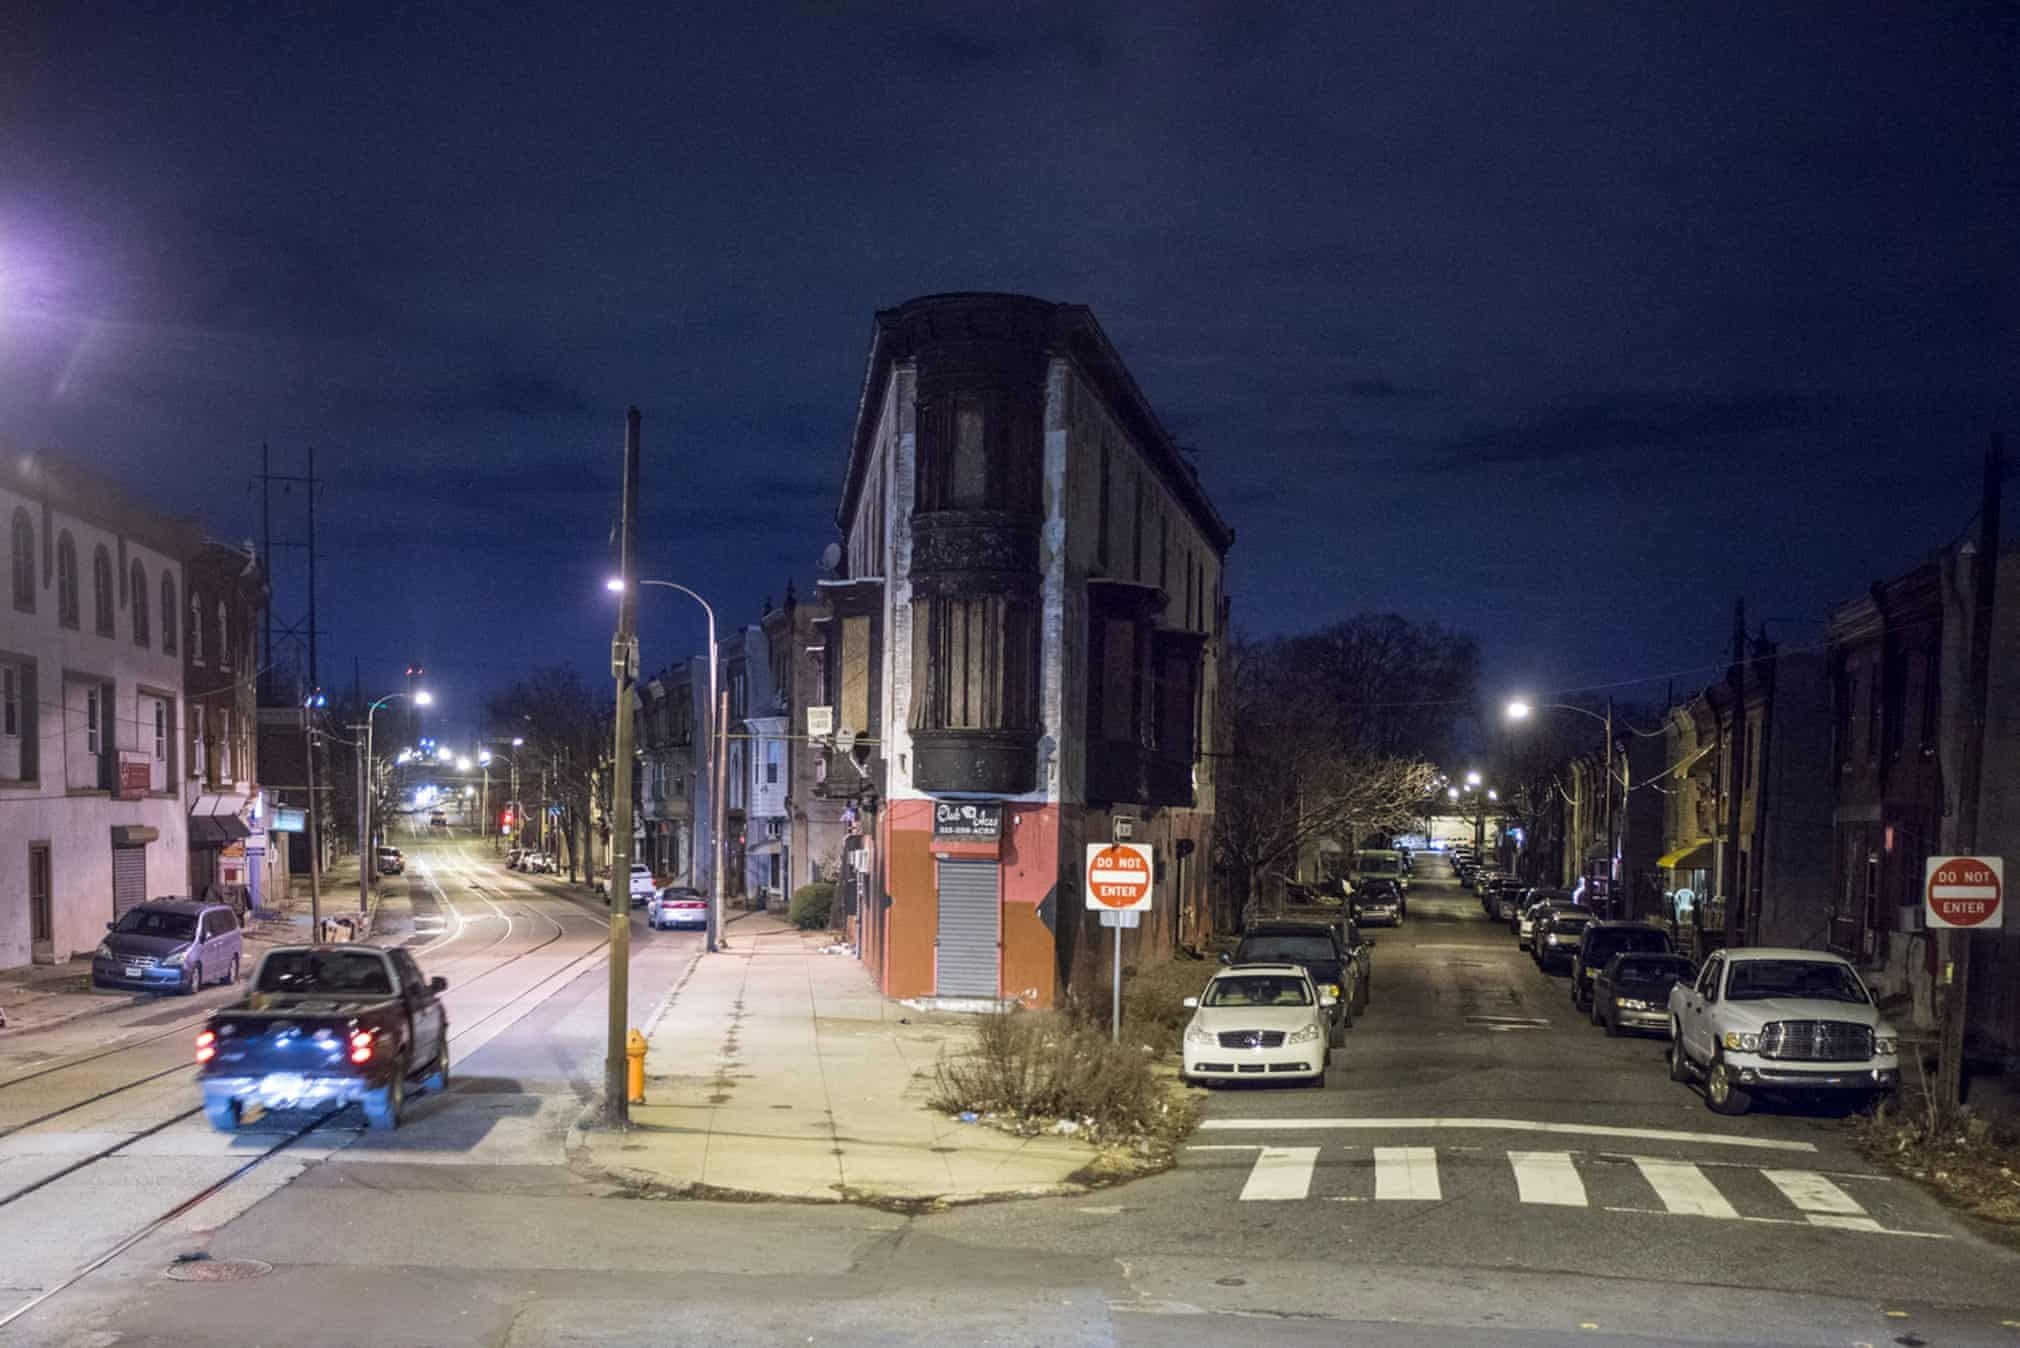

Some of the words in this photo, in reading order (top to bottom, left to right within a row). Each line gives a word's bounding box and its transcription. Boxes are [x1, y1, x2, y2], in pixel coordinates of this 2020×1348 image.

[938, 804, 960, 823] Club
[1097, 857, 1113, 868] DO
[1120, 857, 1142, 868] NOT
[1938, 871, 1956, 882] DO
[1964, 871, 1989, 882] NOT
[1100, 886, 1136, 896] ENTER
[1943, 902, 1984, 913] ENTER
